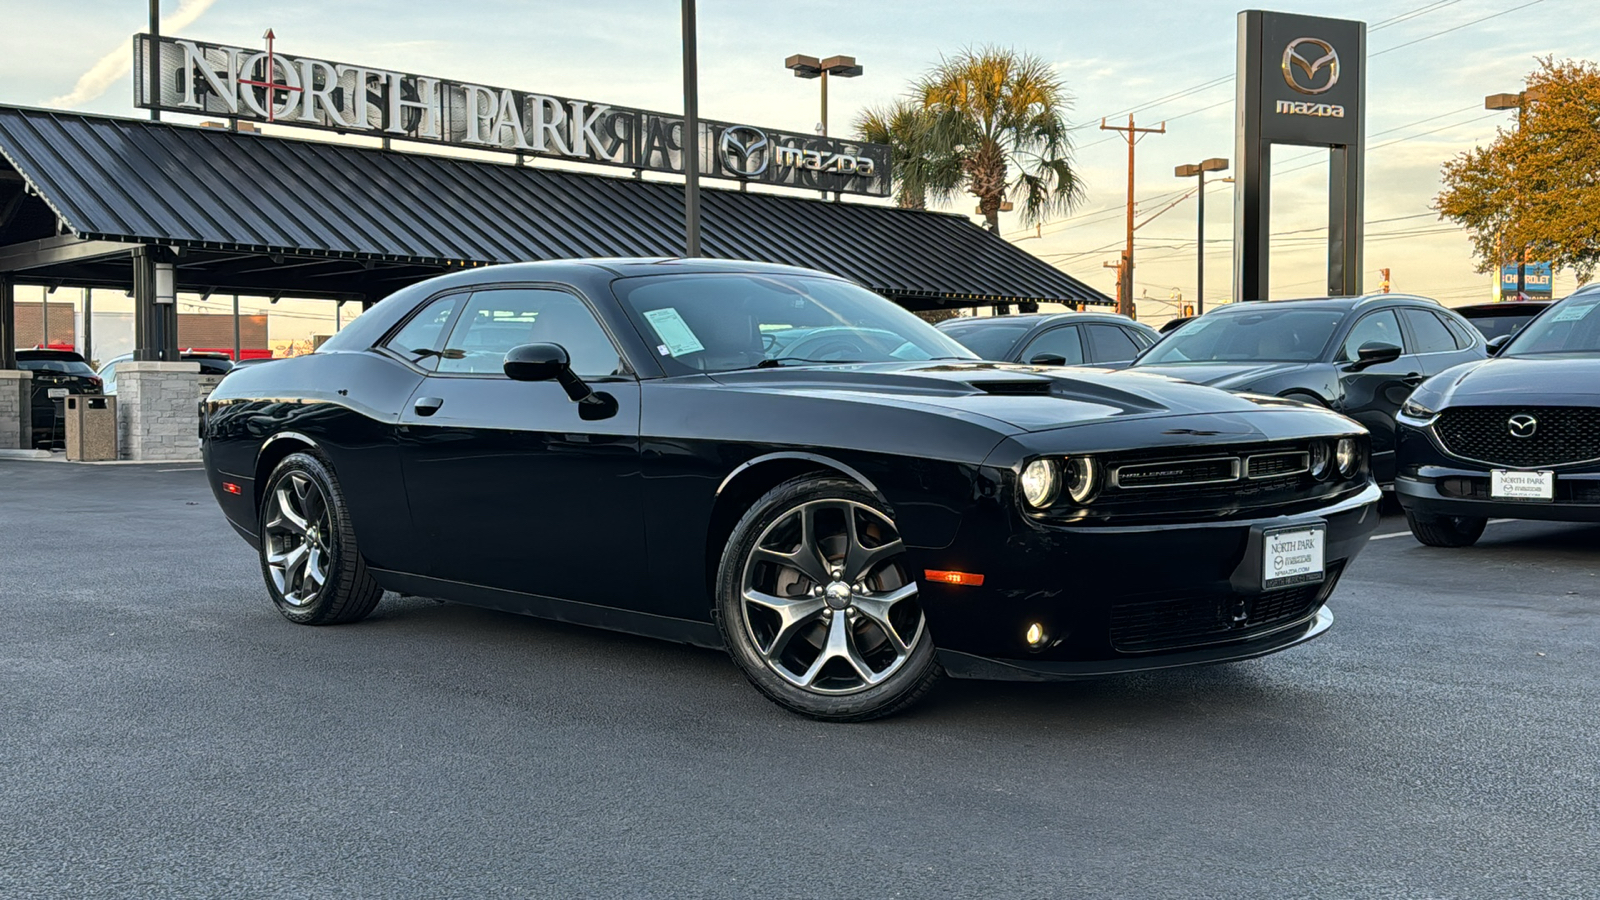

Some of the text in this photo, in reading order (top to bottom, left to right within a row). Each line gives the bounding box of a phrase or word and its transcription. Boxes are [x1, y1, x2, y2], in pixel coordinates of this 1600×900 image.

[175, 40, 614, 160] NORTH PARK
[1276, 100, 1344, 118] mazda
[775, 145, 874, 177] mazda
[1505, 274, 1550, 285] CHROLET
[1527, 477, 1545, 485] PARK
[1271, 539, 1315, 554] NORTH PARK
